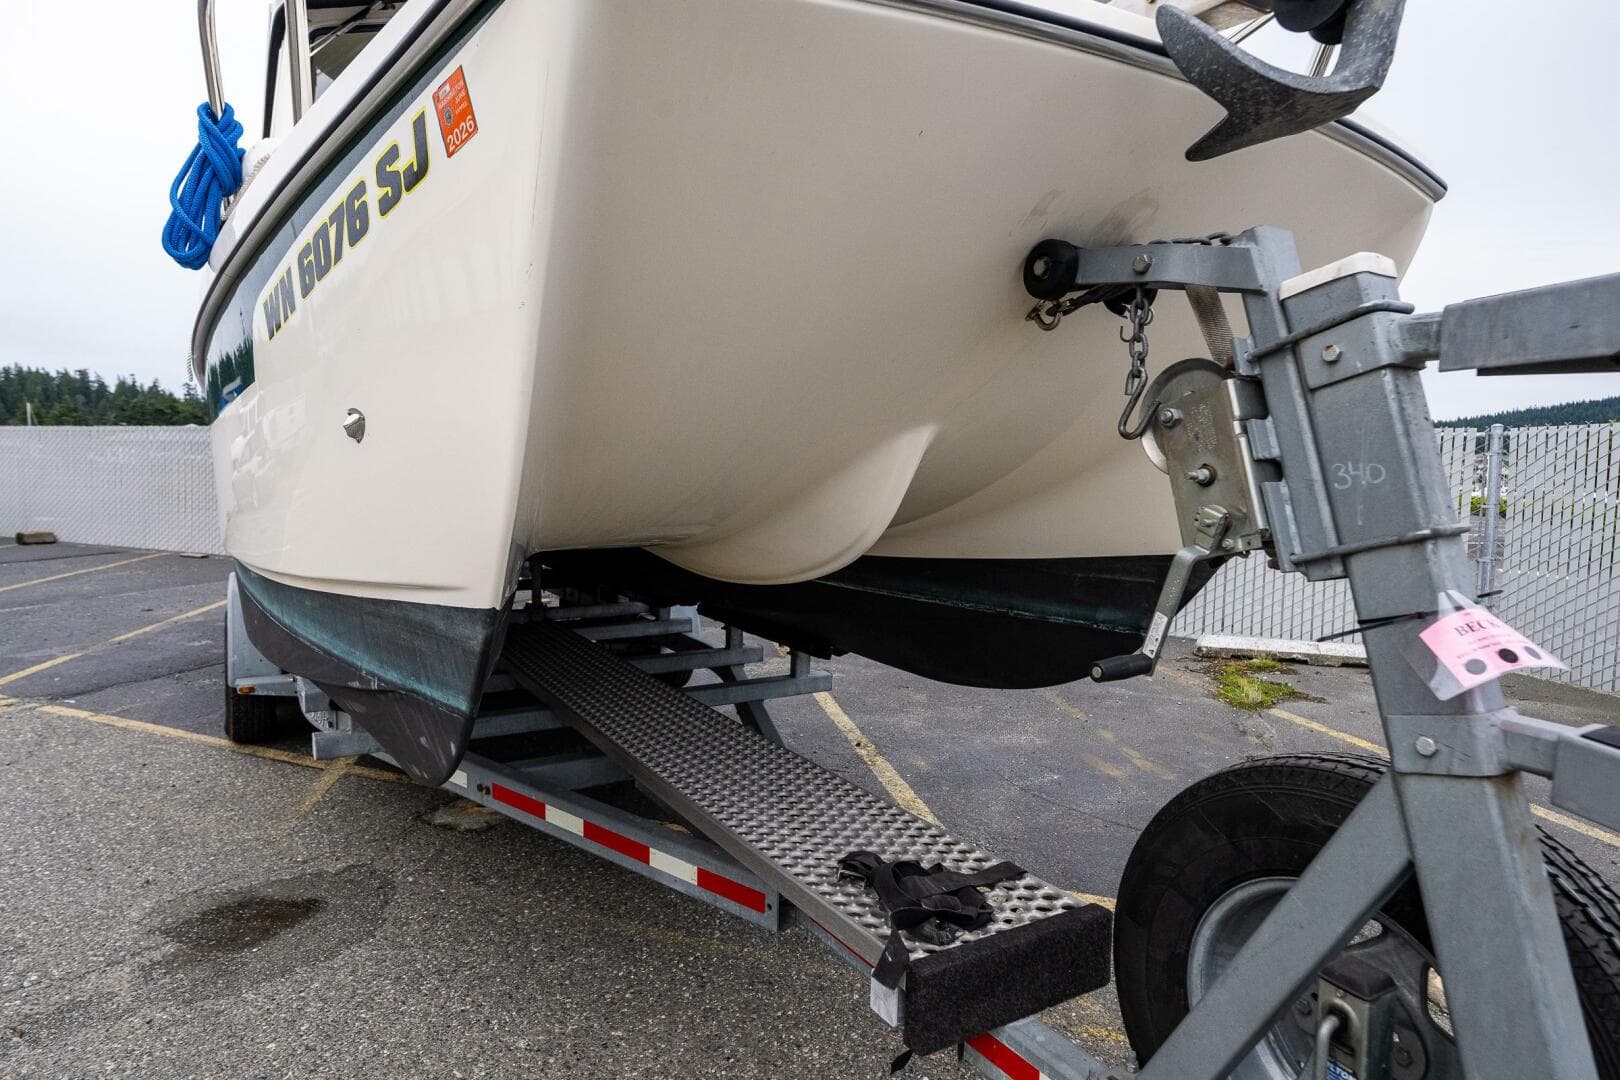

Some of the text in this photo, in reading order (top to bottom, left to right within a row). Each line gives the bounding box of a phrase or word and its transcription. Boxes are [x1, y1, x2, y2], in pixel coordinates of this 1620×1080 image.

[447, 115, 475, 152] 2026
[262, 107, 429, 341] WN 6076 SJ
[1331, 461, 1386, 490] 340
